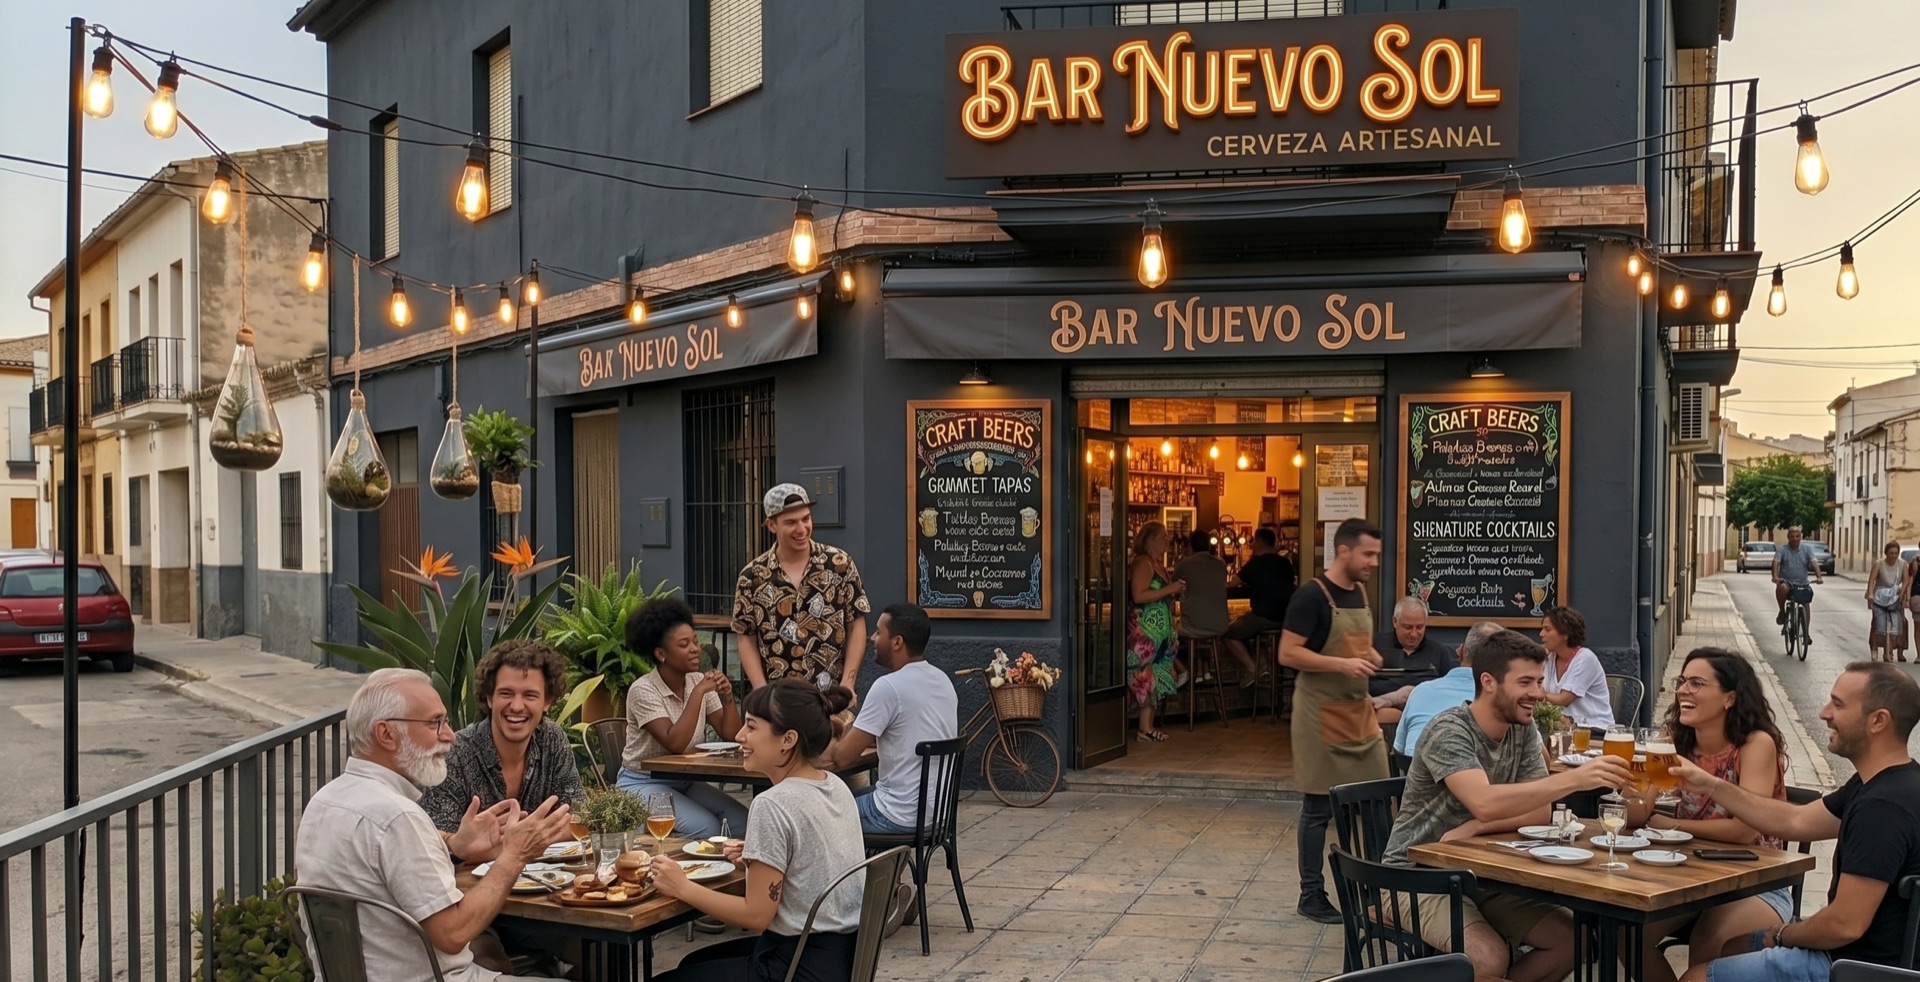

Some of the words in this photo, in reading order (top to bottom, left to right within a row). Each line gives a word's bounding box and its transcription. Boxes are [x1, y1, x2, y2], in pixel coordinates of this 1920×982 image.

[959, 44, 1102, 141] BAR
[1113, 31, 1343, 135] NUEVO
[1360, 24, 1501, 123] SOL
[1207, 132, 1328, 157] CERVEZA
[1338, 125, 1501, 152] ARTESANAL
[1050, 299, 1139, 354] BAR
[1154, 296, 1301, 352] NUEVO
[1316, 293, 1406, 351] SOL
[619, 335, 678, 381] NUEVO
[684, 323, 724, 370] SOL
[926, 417, 977, 448] CRAFT
[983, 417, 1034, 449] BEERS
[1428, 409, 1482, 433] CRAFT
[1487, 408, 1540, 433] BEERS
[991, 477, 1032, 494] TAPAS
[1486, 521, 1555, 538] COCKTAILS
